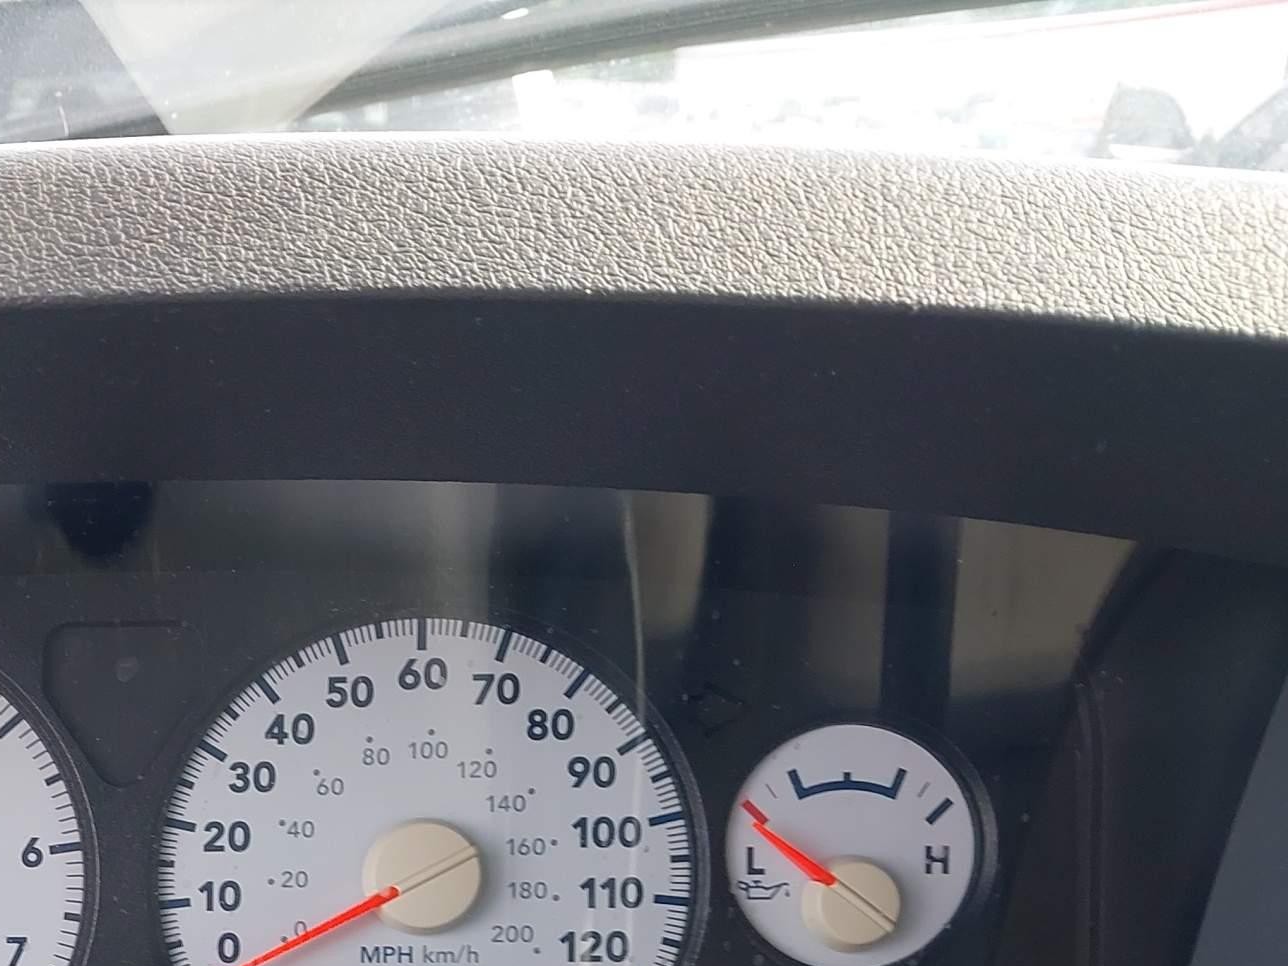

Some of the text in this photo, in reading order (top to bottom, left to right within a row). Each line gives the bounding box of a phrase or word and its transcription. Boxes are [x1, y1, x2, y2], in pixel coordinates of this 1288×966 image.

[397, 657, 448, 691] 60
[472, 672, 521, 705] 70
[325, 675, 374, 709] 50
[264, 712, 315, 746] 40
[526, 708, 575, 741] 80
[362, 747, 390, 766] 80
[408, 740, 449, 760] 100
[228, 761, 276, 794] 30
[457, 760, 498, 779] 120
[567, 756, 616, 789] 90
[316, 777, 345, 796] 60
[486, 794, 527, 813] 140
[203, 820, 251, 853] 20
[286, 820, 315, 839] 40
[571, 816, 642, 849] 100
[21, 837, 44, 868] 6
[506, 837, 546, 857] 160
[746, 846, 766, 876] L
[924, 845, 950, 875] H
[281, 870, 309, 889] 20
[507, 881, 548, 900] 180
[579, 876, 644, 909] 110
[198, 880, 242, 912] 10
[217, 932, 241, 964] 0
[491, 924, 534, 943] 200
[559, 930, 629, 963] 120
[360, 944, 480, 964] MPH km/h
